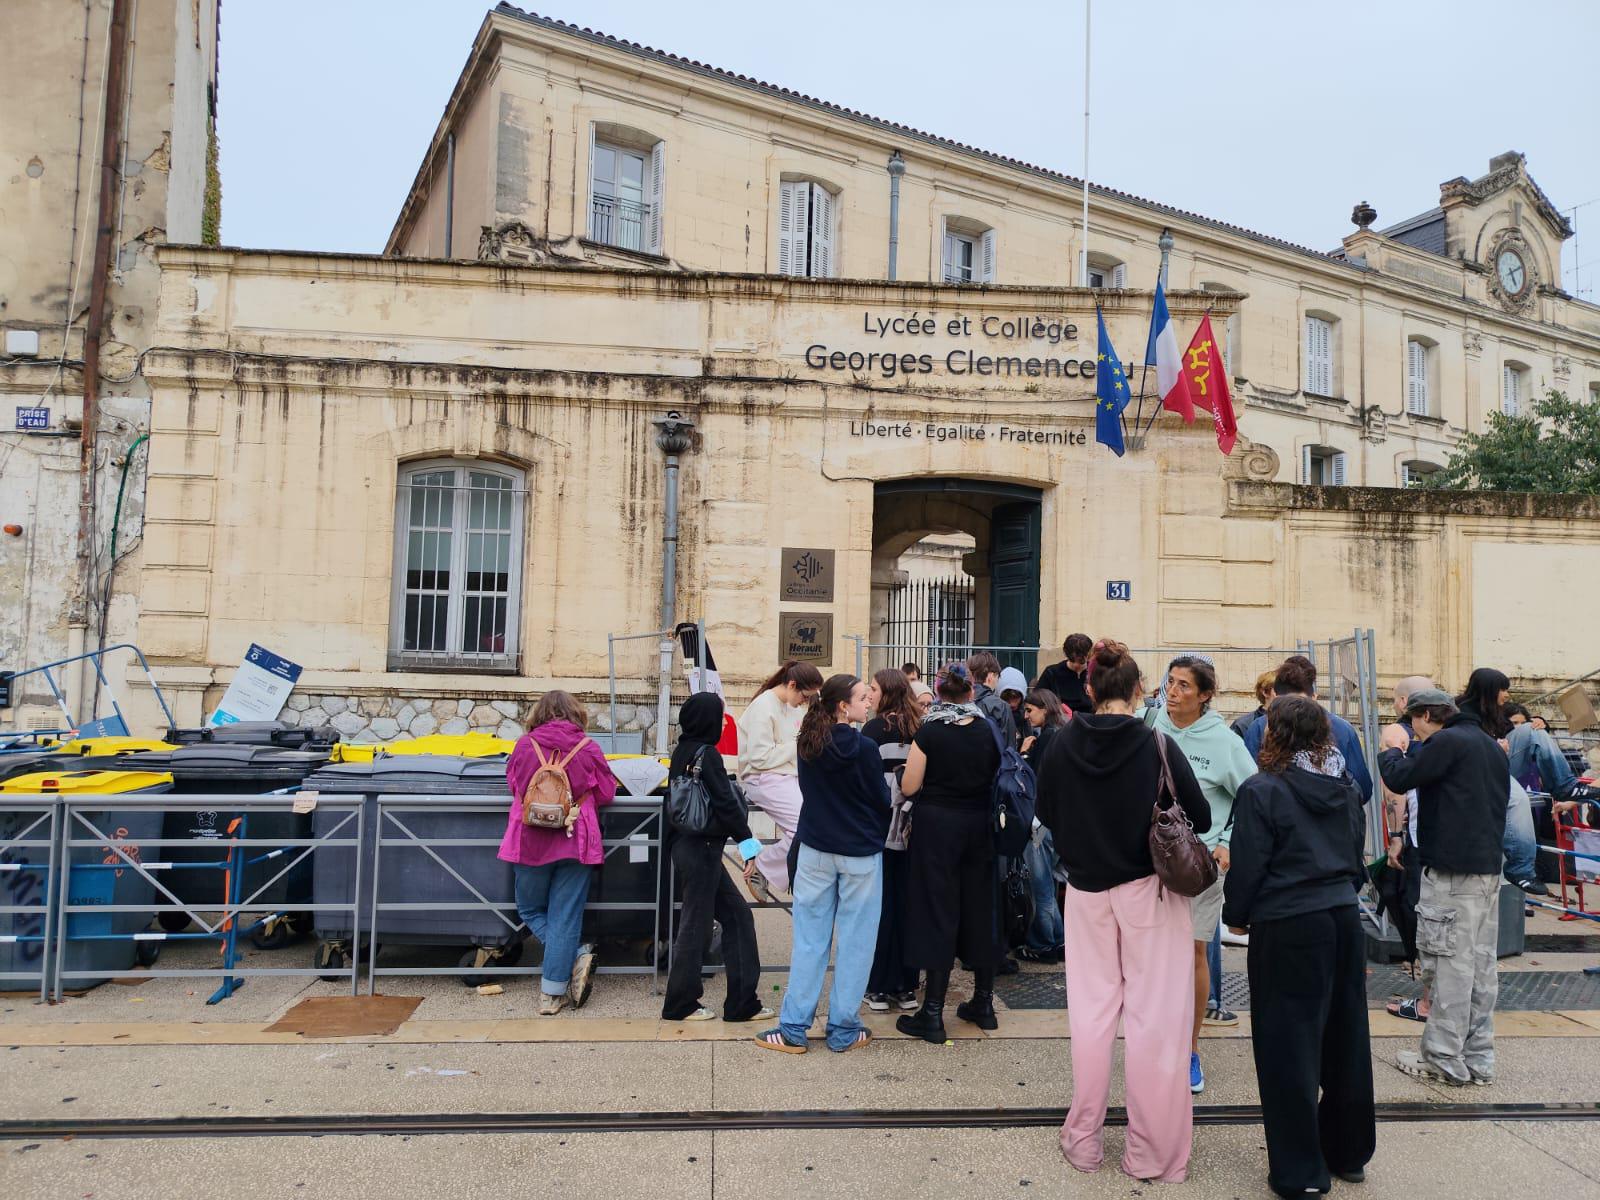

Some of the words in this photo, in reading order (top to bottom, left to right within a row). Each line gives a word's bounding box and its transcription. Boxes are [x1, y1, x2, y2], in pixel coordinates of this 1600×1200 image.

[864, 311, 936, 338] Lycée
[947, 316, 972, 336] et
[982, 315, 1078, 344] Collège
[805, 344, 933, 378] Georges
[946, 349, 1134, 380] Clemenceu
[18, 418, 46, 426] D'EAU
[19, 410, 47, 418] PRISE
[851, 420, 912, 438] Liberté
[926, 422, 985, 441] Egalité
[1000, 426, 1087, 445] Fraternité
[1111, 583, 1126, 598] 31
